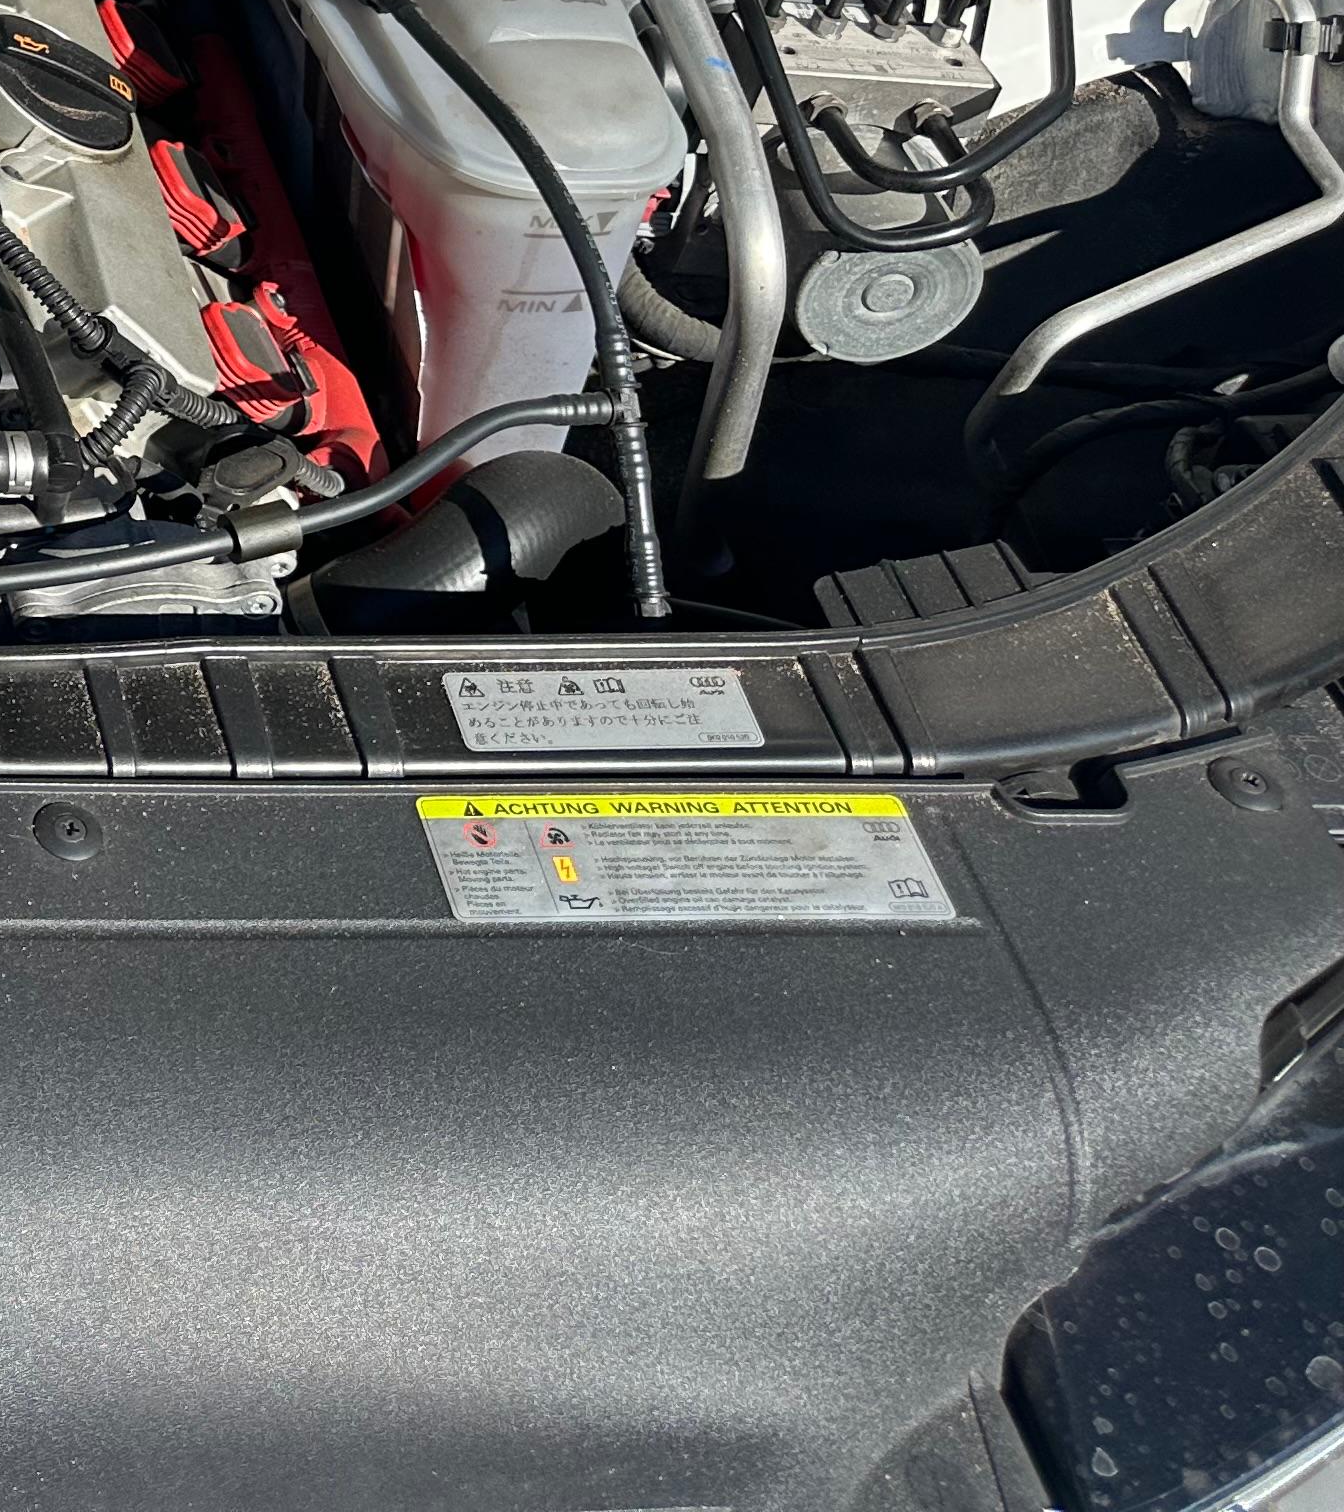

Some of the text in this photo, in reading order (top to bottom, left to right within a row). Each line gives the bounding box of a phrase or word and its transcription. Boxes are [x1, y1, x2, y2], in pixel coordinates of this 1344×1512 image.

[529, 214, 595, 230] MX
[496, 299, 557, 314] MIN
[496, 678, 535, 694] 注意
[494, 801, 853, 816] ACHTUNG WARNING ATTENTION
